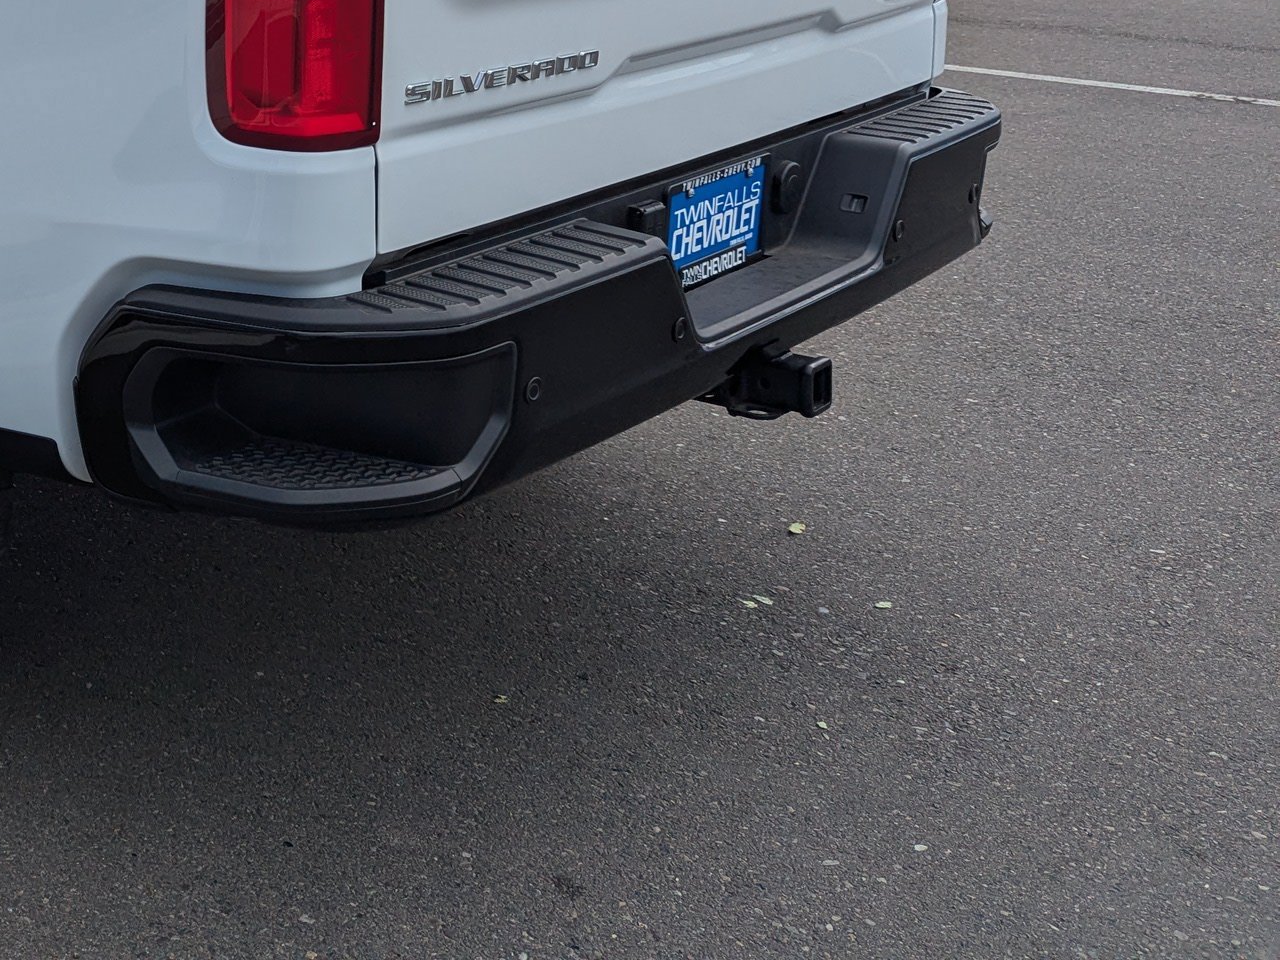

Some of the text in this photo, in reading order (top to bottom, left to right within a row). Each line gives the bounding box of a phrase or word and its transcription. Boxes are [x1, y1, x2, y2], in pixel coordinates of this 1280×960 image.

[404, 49, 600, 106] SILVERADO
[671, 198, 759, 260] CHEVROLET
[701, 246, 747, 280] CHEVROLET
